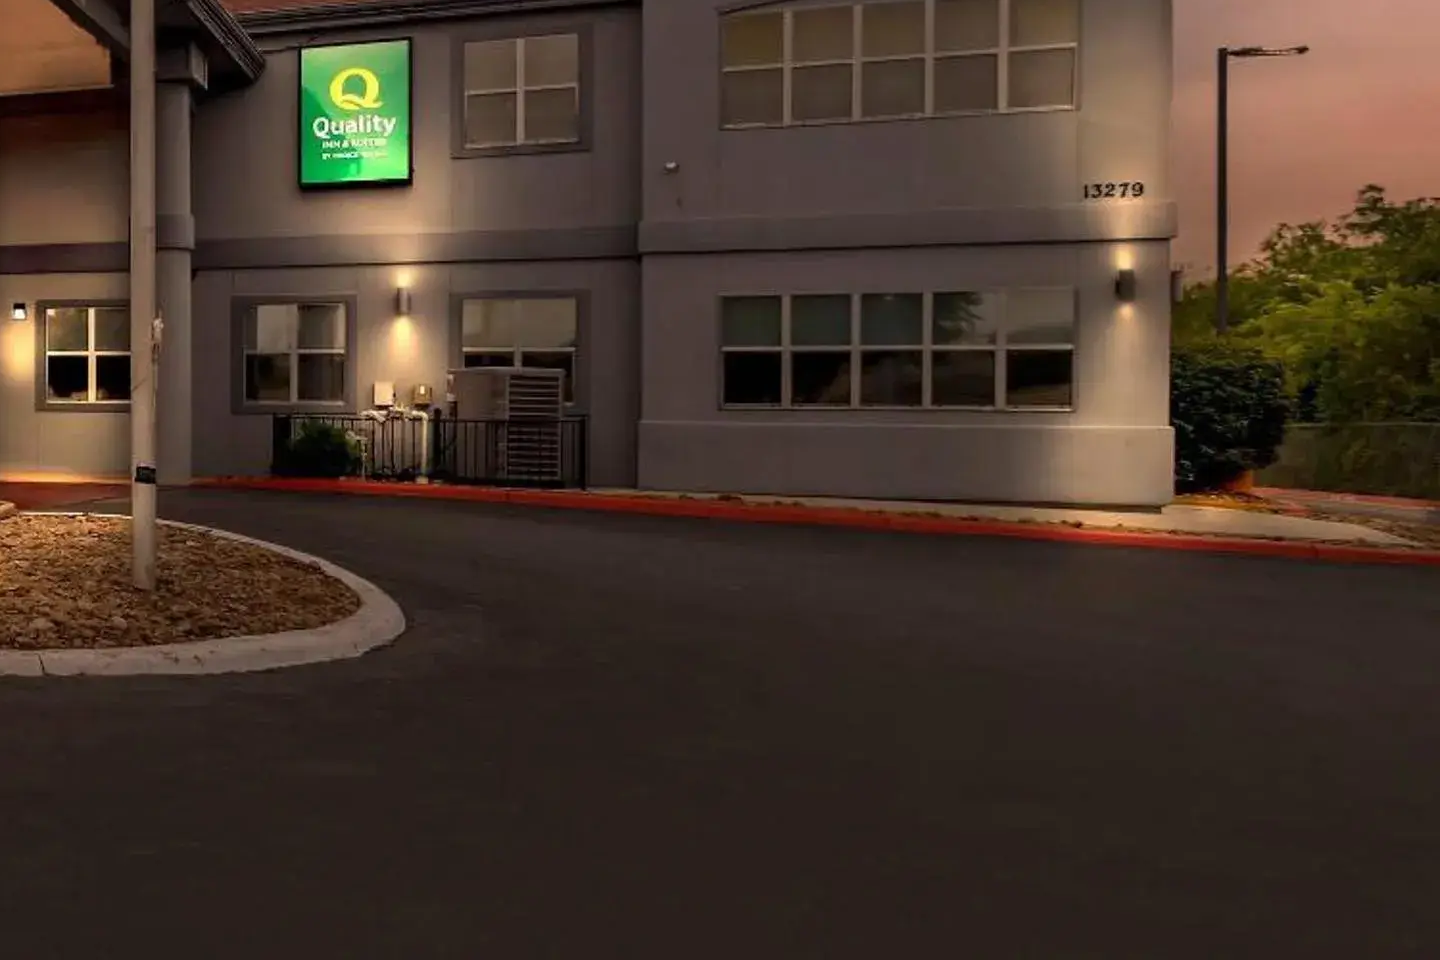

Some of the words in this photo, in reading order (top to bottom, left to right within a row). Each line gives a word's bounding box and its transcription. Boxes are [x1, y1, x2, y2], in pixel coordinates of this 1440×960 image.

[329, 67, 383, 110] Q
[313, 115, 396, 139] Quality
[1084, 182, 1144, 199] 13279
